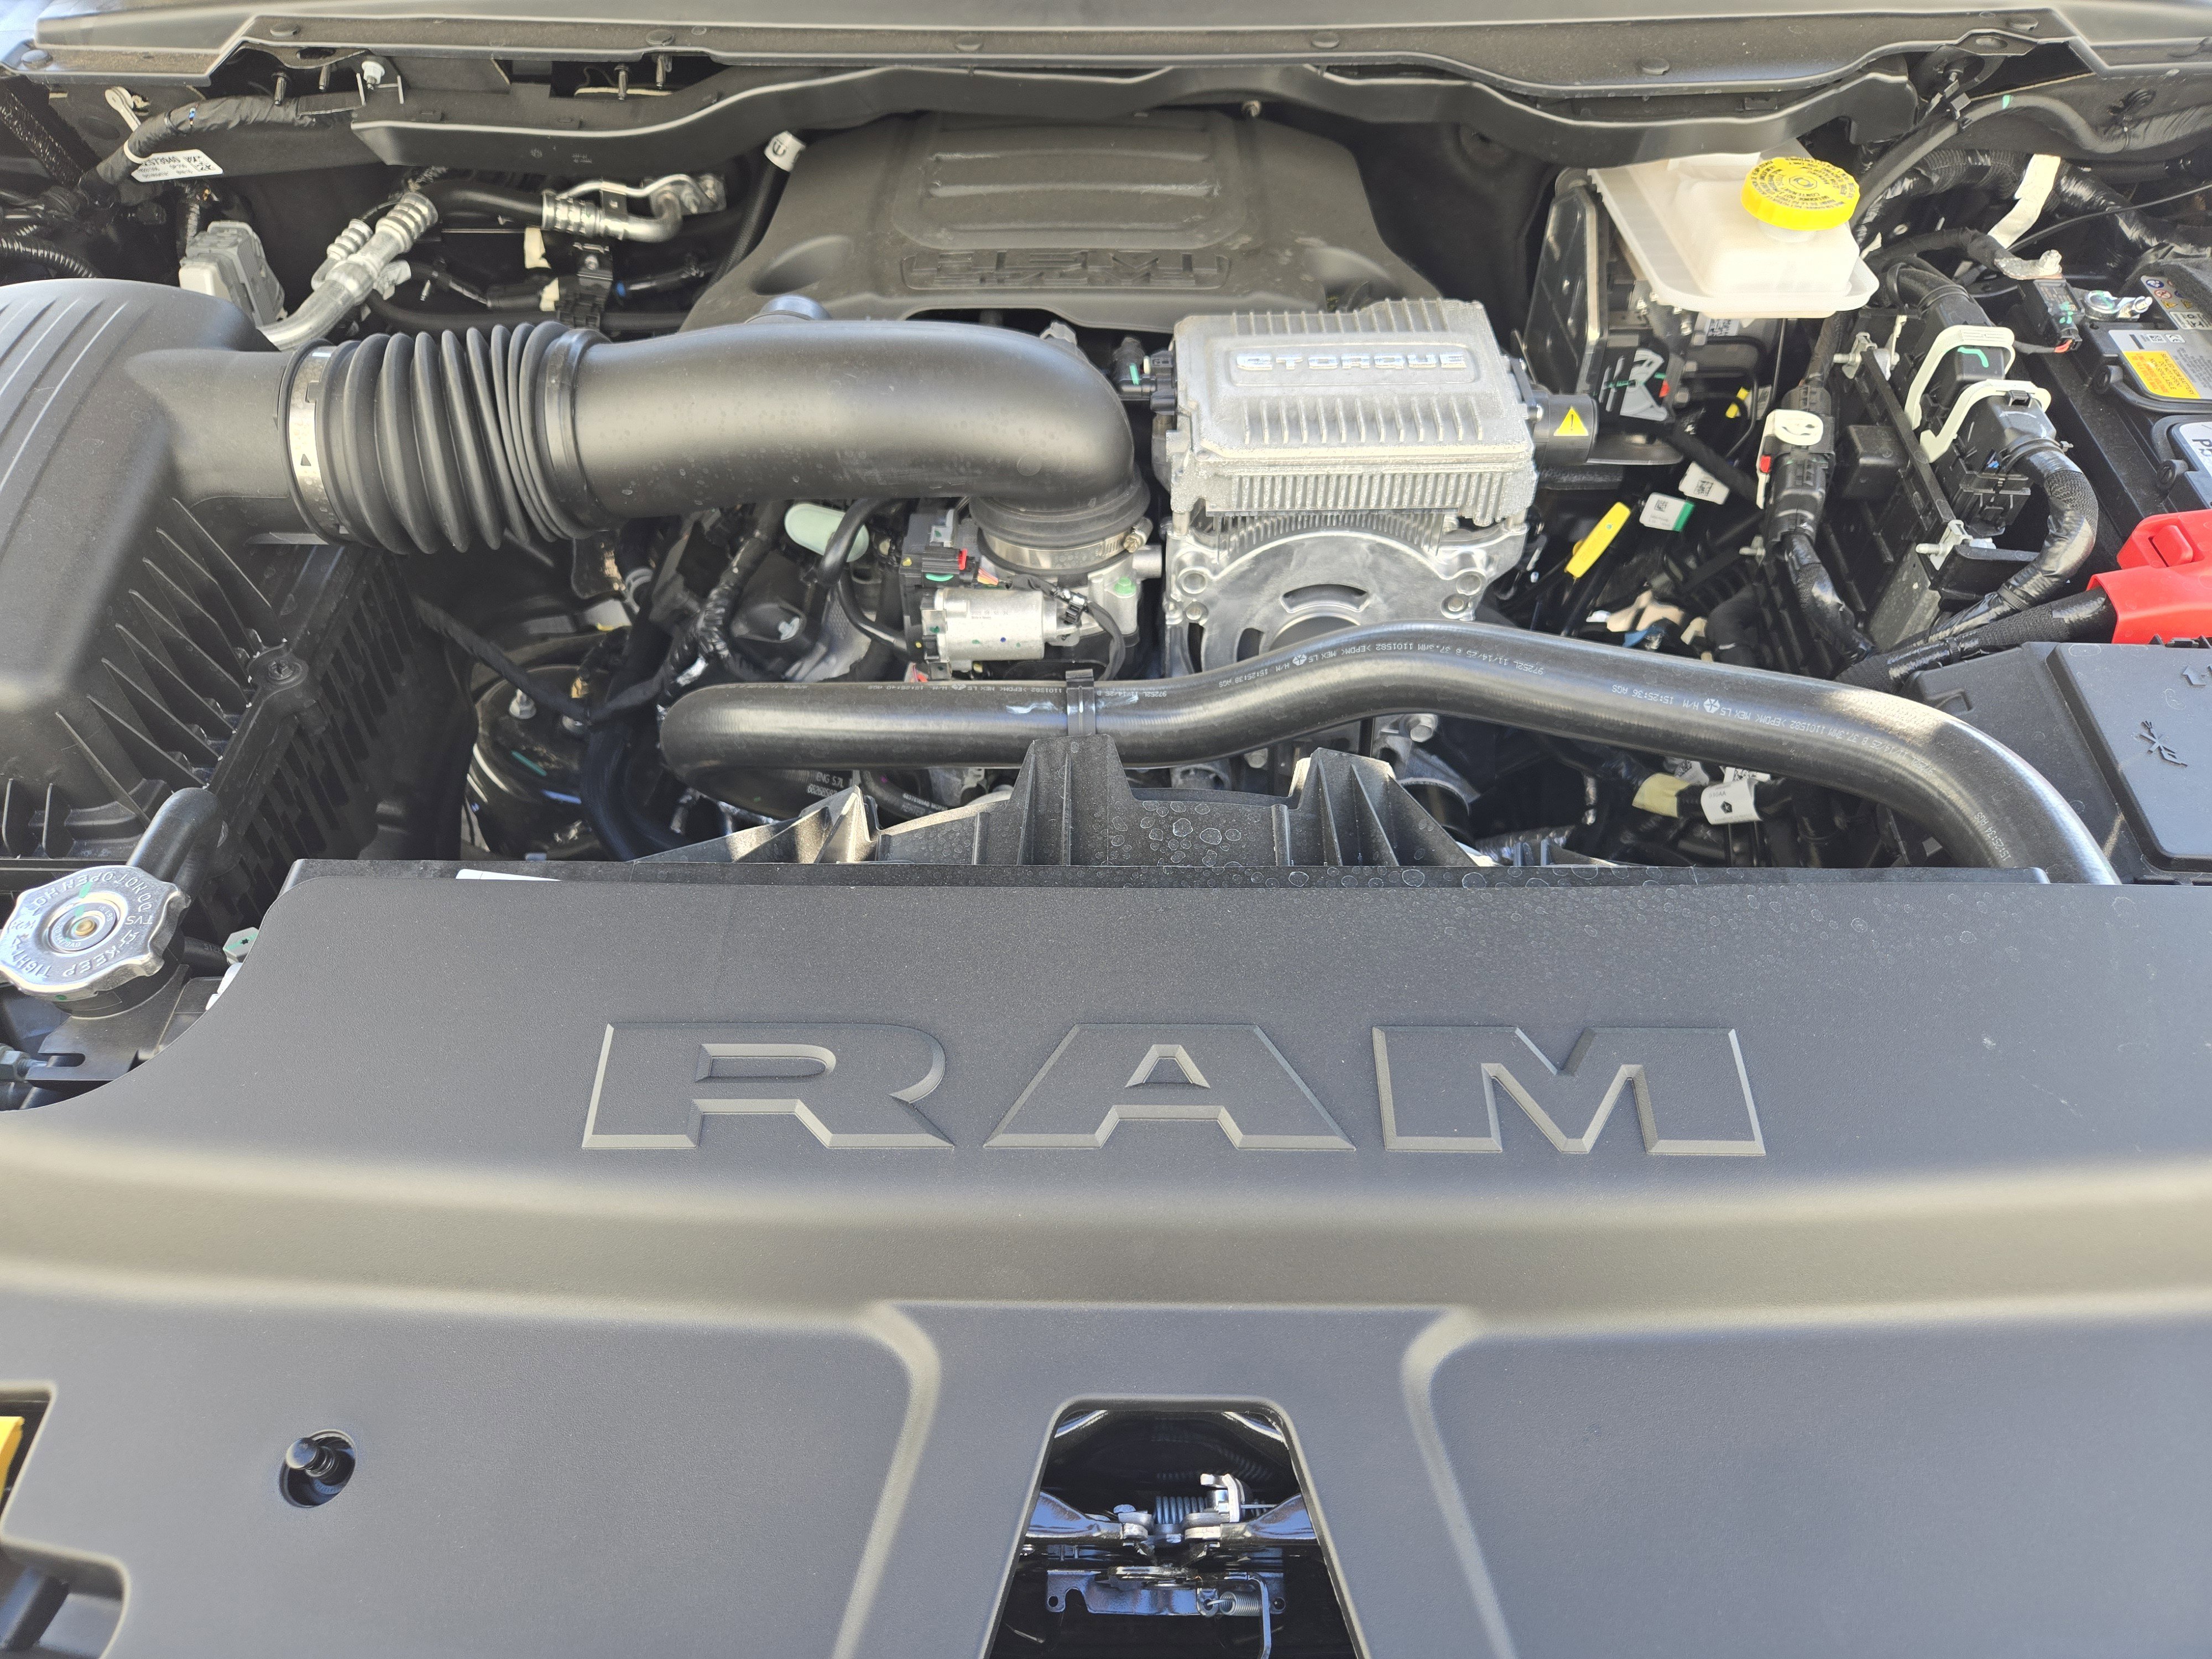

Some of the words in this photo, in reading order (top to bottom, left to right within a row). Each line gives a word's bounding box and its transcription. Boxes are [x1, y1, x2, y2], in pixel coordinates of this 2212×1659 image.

[1375, 643, 1413, 651] 1101582
[1320, 650, 1336, 660] MEX
[1465, 650, 1508, 666] 11/14/25
[1275, 662, 1290, 672] H/M
[1513, 660, 1544, 675] 97252L
[1611, 684, 1629, 695] AGS
[1632, 688, 1674, 705] 15:25:36
[1682, 699, 1699, 710] H/M
[1735, 709, 1751, 721] MEX
[1790, 719, 1826, 732] 1101582
[1870, 740, 1908, 760] 11/14/25
[816, 772, 830, 783] ENG
[1974, 811, 1989, 827] AGS
[1985, 827, 2012, 862] 15:25:34
[125, 915, 153, 925] TVS
[62, 945, 120, 978] KEEP
[581, 1022, 1766, 1155] RAM
